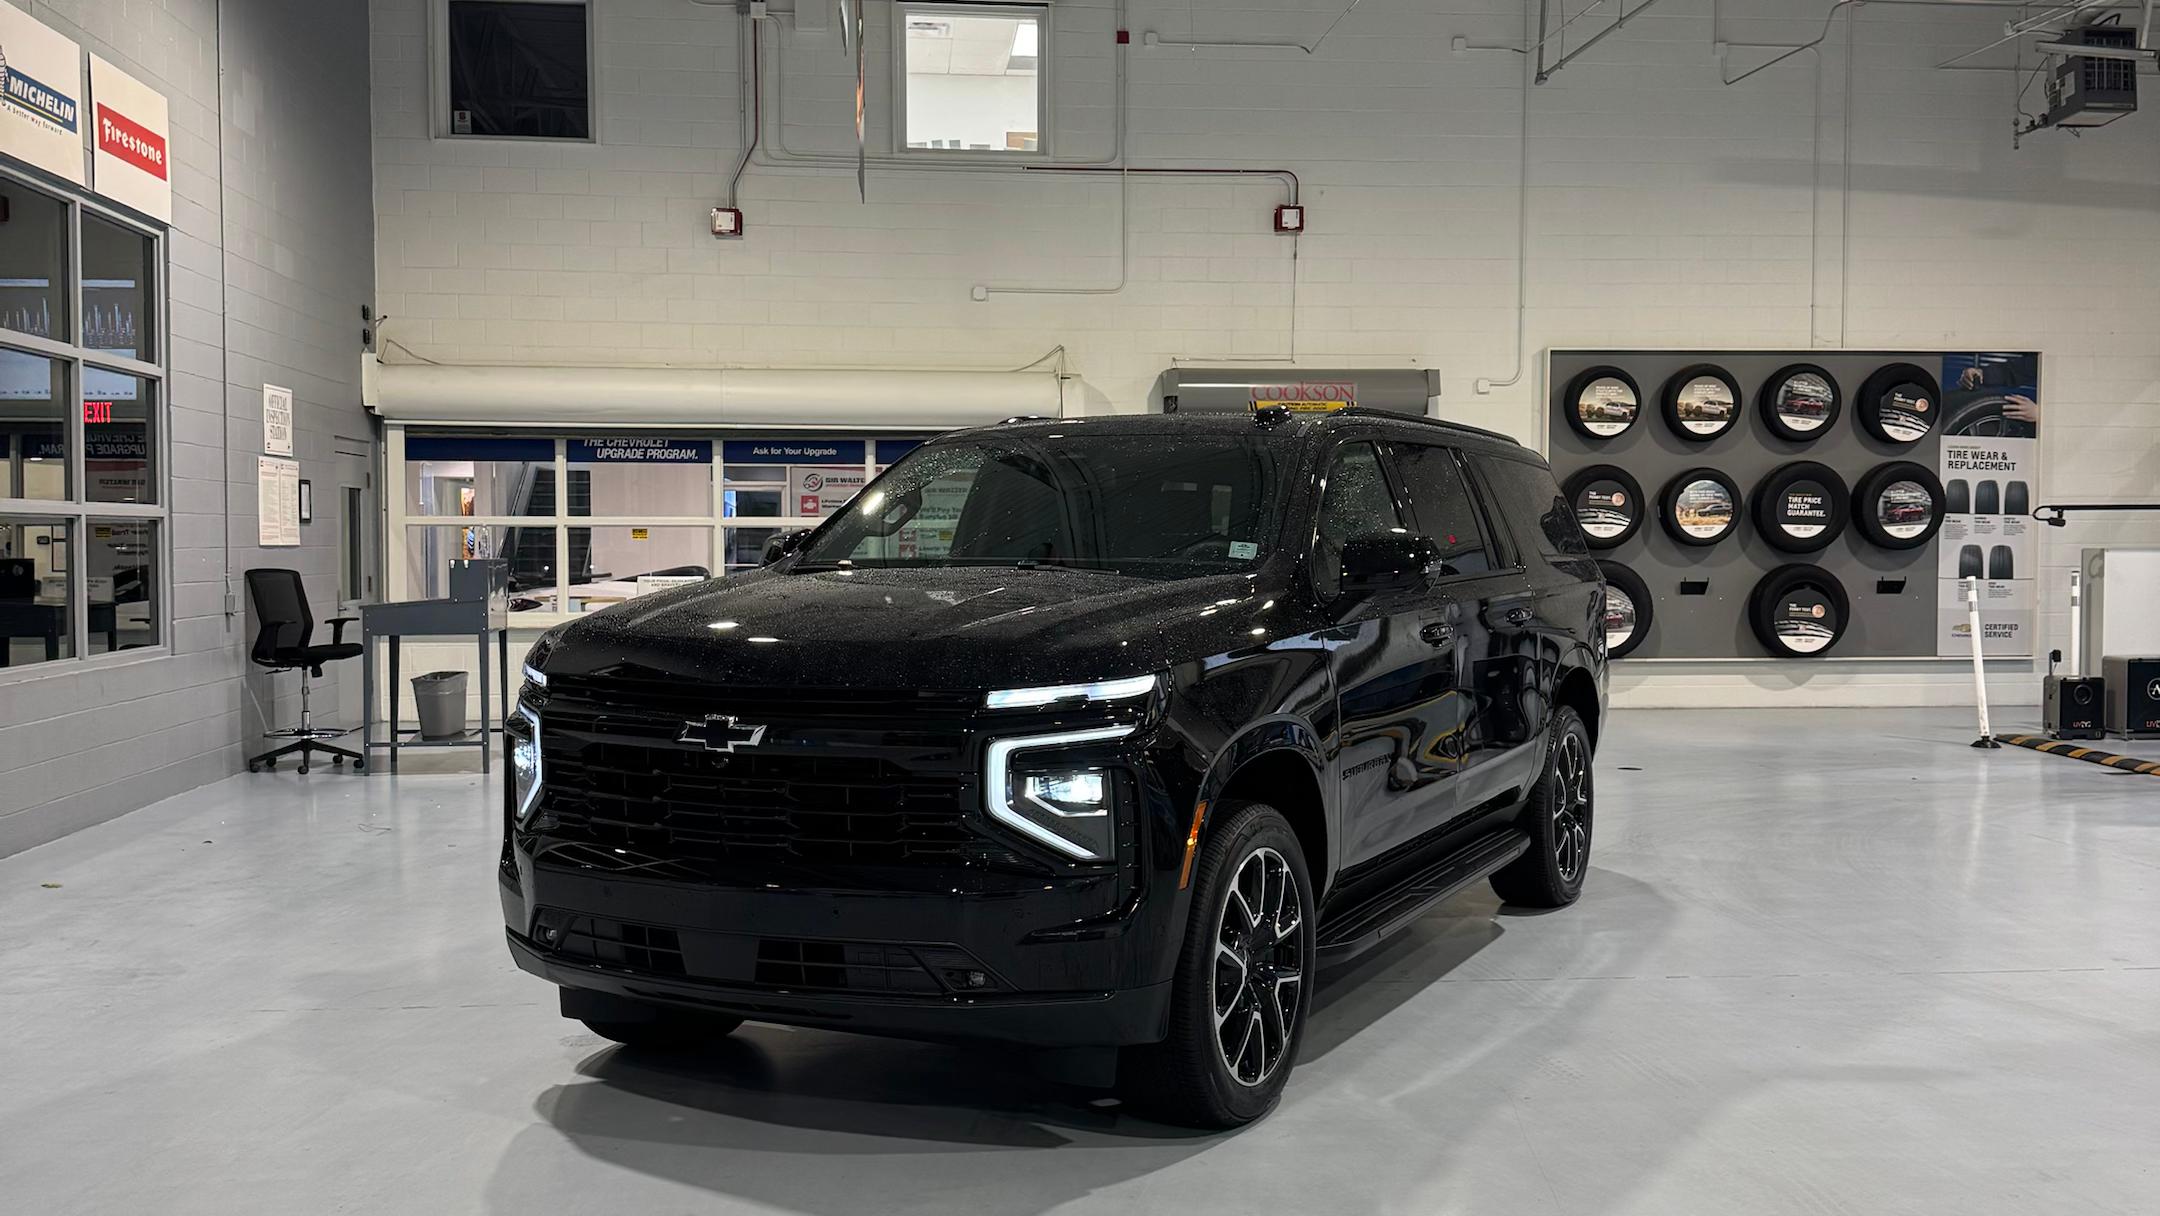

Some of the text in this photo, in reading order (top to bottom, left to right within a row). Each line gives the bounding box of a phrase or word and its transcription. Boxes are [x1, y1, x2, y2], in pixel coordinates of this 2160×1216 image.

[10, 76, 75, 122] MICHELIN
[103, 117, 162, 165] Firestone
[1252, 381, 1354, 400] COOKSON
[84, 402, 113, 424] EXIT
[606, 439, 669, 448] CHEVROLET
[597, 448, 698, 460] UPGRADE PROGRAM.
[753, 447, 837, 457] Ask for Your Upgrade
[1947, 451, 2008, 460] TIRE WEAR &
[1948, 461, 2016, 471] REPLACEMENT
[1787, 509, 1826, 517] GUARANTEE.
